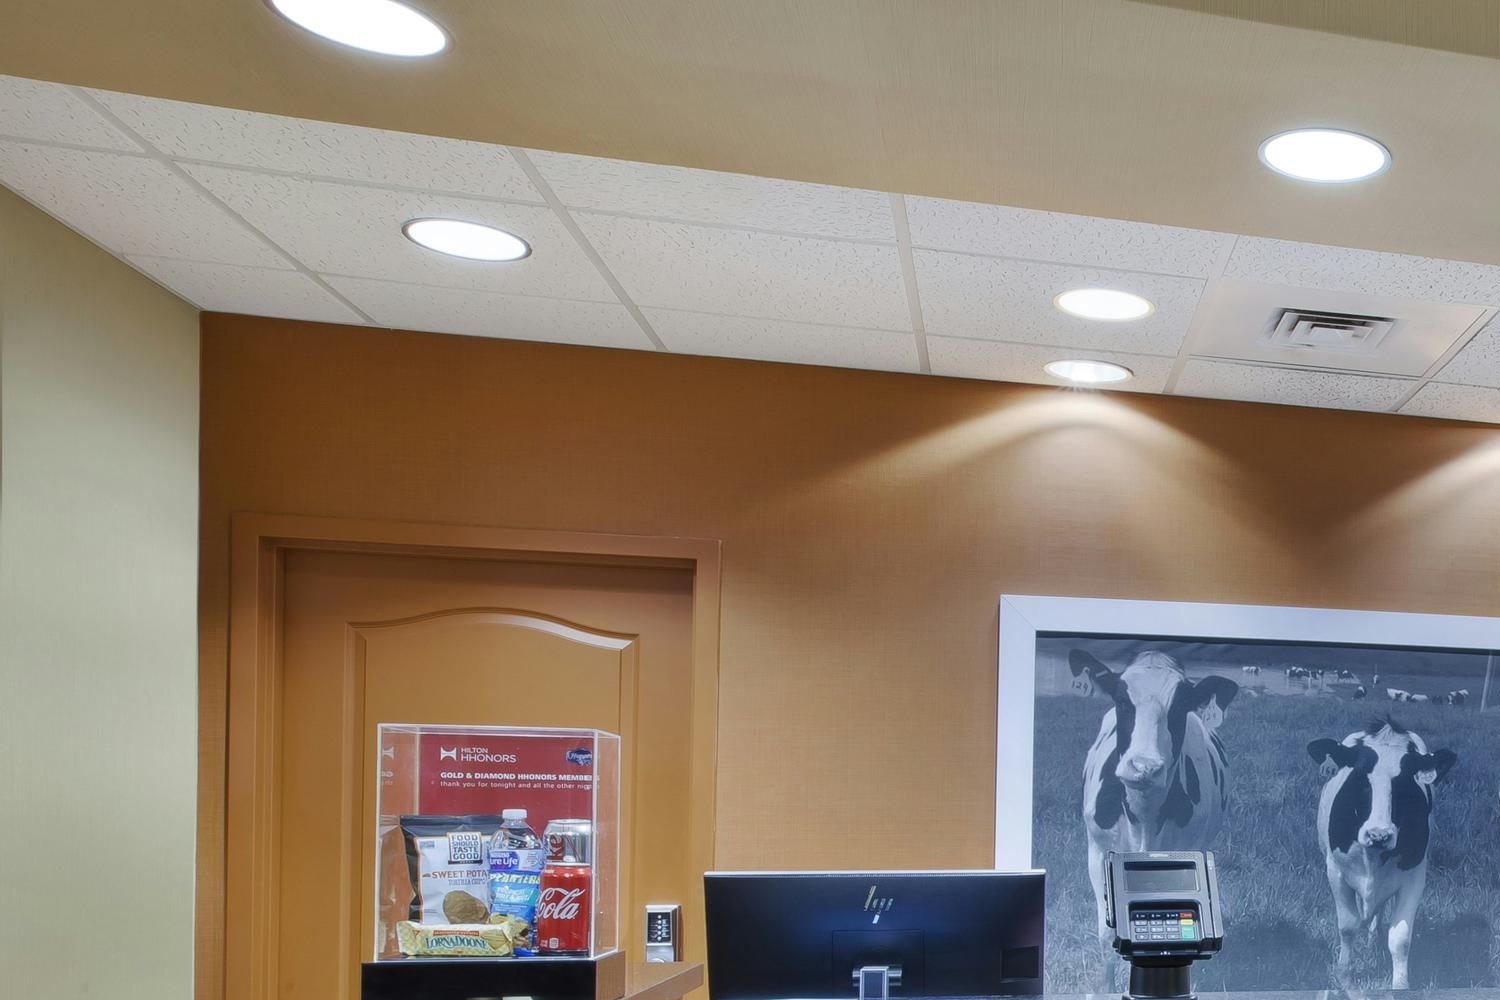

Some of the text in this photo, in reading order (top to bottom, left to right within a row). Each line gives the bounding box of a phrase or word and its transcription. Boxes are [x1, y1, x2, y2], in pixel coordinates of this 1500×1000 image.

[460, 754, 517, 763] HHONORS
[517, 773, 557, 781] HHONORS
[490, 857, 503, 866] ure
[432, 869, 487, 879] SWEET POTA
[536, 887, 586, 920] Cola
